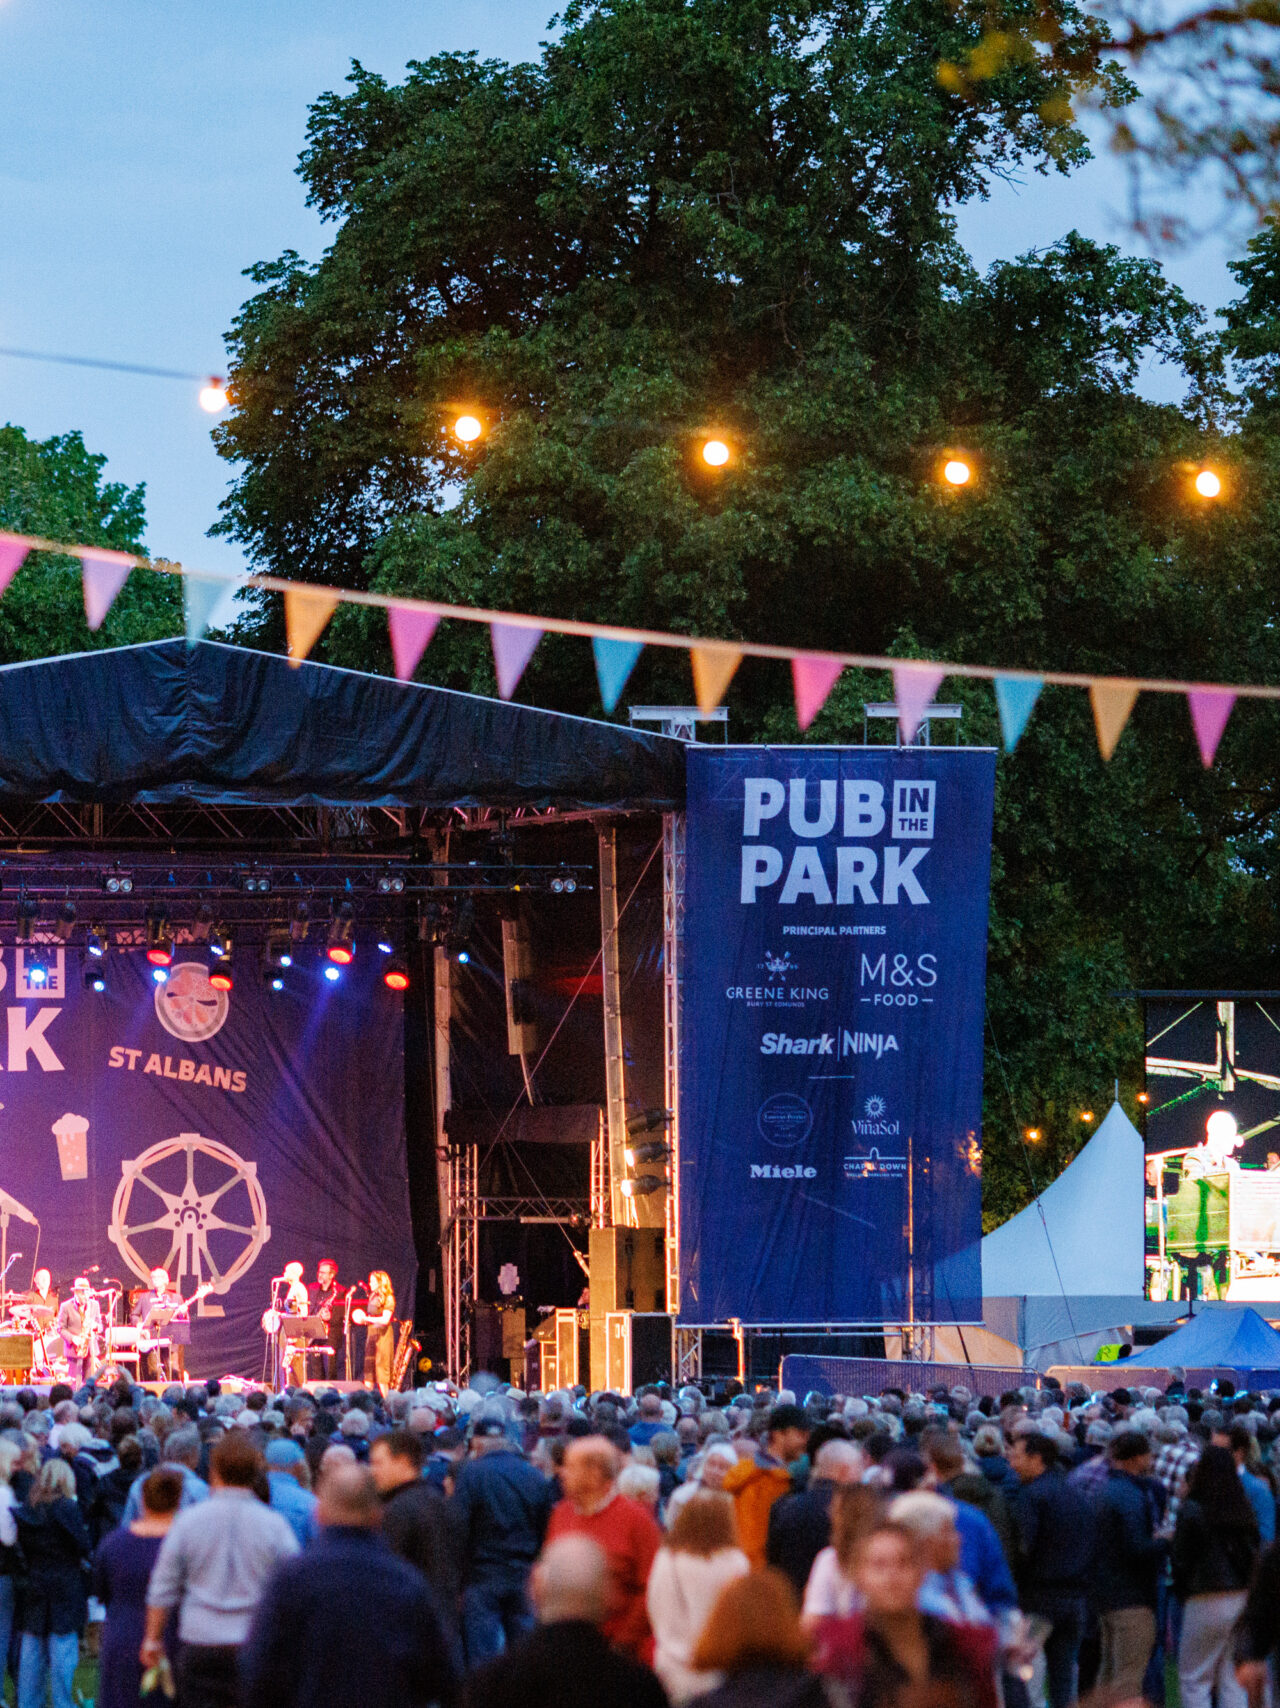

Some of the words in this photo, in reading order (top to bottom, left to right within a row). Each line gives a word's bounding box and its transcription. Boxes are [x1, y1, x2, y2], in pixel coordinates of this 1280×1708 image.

[744, 778, 886, 838] PUB
[899, 788, 929, 812] IN
[898, 818, 928, 831] THE
[740, 845, 931, 905] PARK
[783, 926, 837, 936] PRINCIPAL
[840, 926, 886, 935] PARTNERS
[861, 953, 937, 987] M&S
[726, 986, 784, 999] GREENE
[790, 987, 829, 1000] KING
[874, 993, 919, 1006] FOOD
[760, 1032, 836, 1055] Shark
[108, 1046, 142, 1071] ST
[143, 1053, 247, 1092] ALBANS
[750, 1164, 817, 1178] Miele
